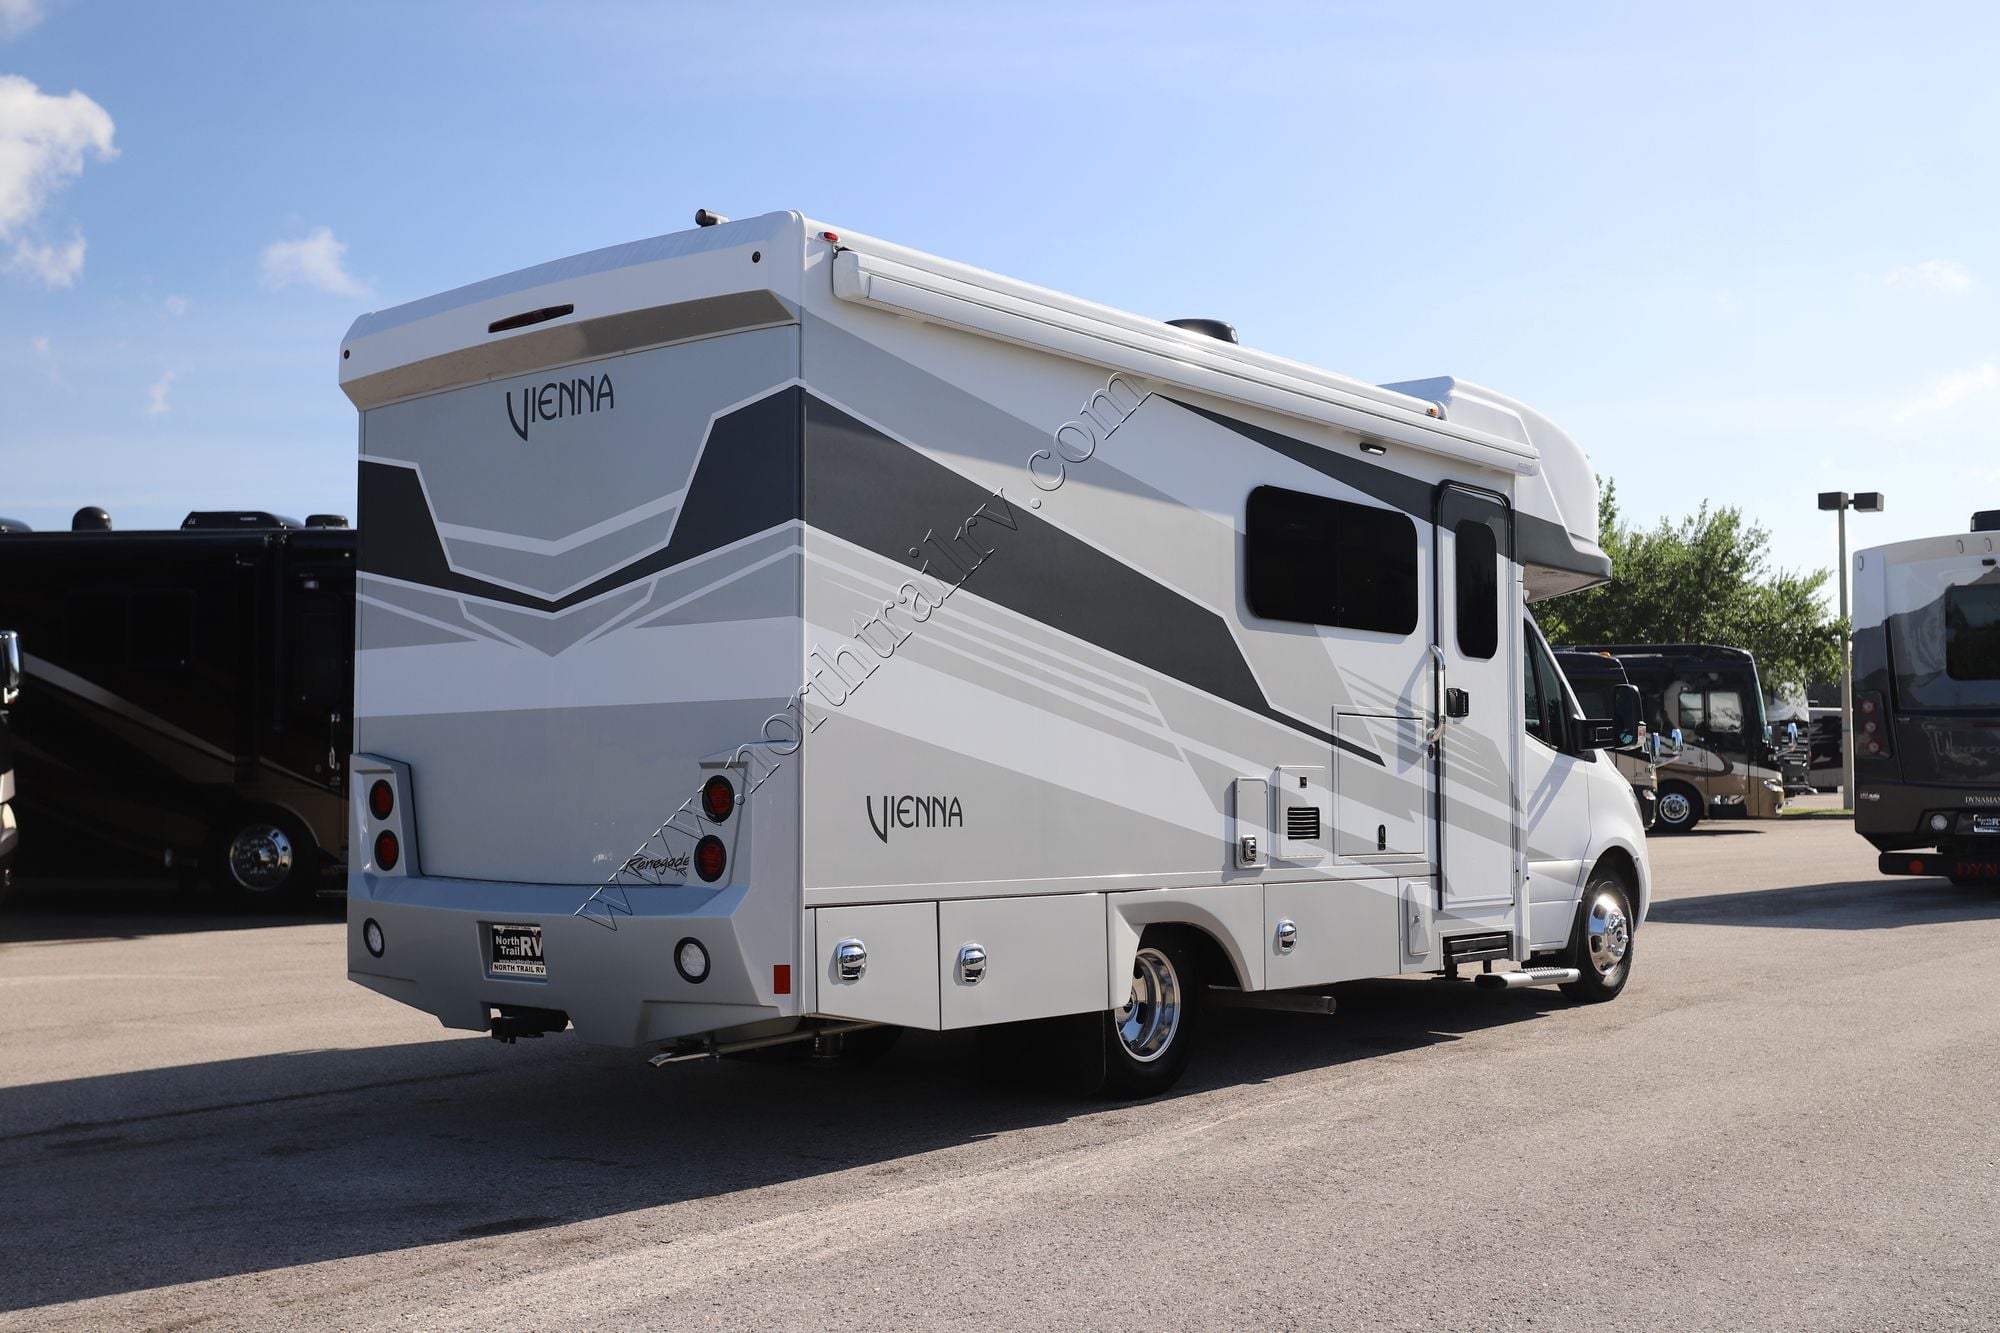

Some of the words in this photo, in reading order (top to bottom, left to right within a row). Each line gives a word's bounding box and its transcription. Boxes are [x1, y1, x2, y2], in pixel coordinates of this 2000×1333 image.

[506, 373, 614, 442] VIENNA
[866, 795, 963, 844] VIENNA
[622, 851, 690, 875] Renegade
[495, 935, 520, 946] North
[500, 946, 520, 956] Trail
[520, 936, 543, 957] RV
[494, 964, 515, 972] NORTH
[516, 965, 534, 973] TRAIL
[536, 966, 544, 974] RV
